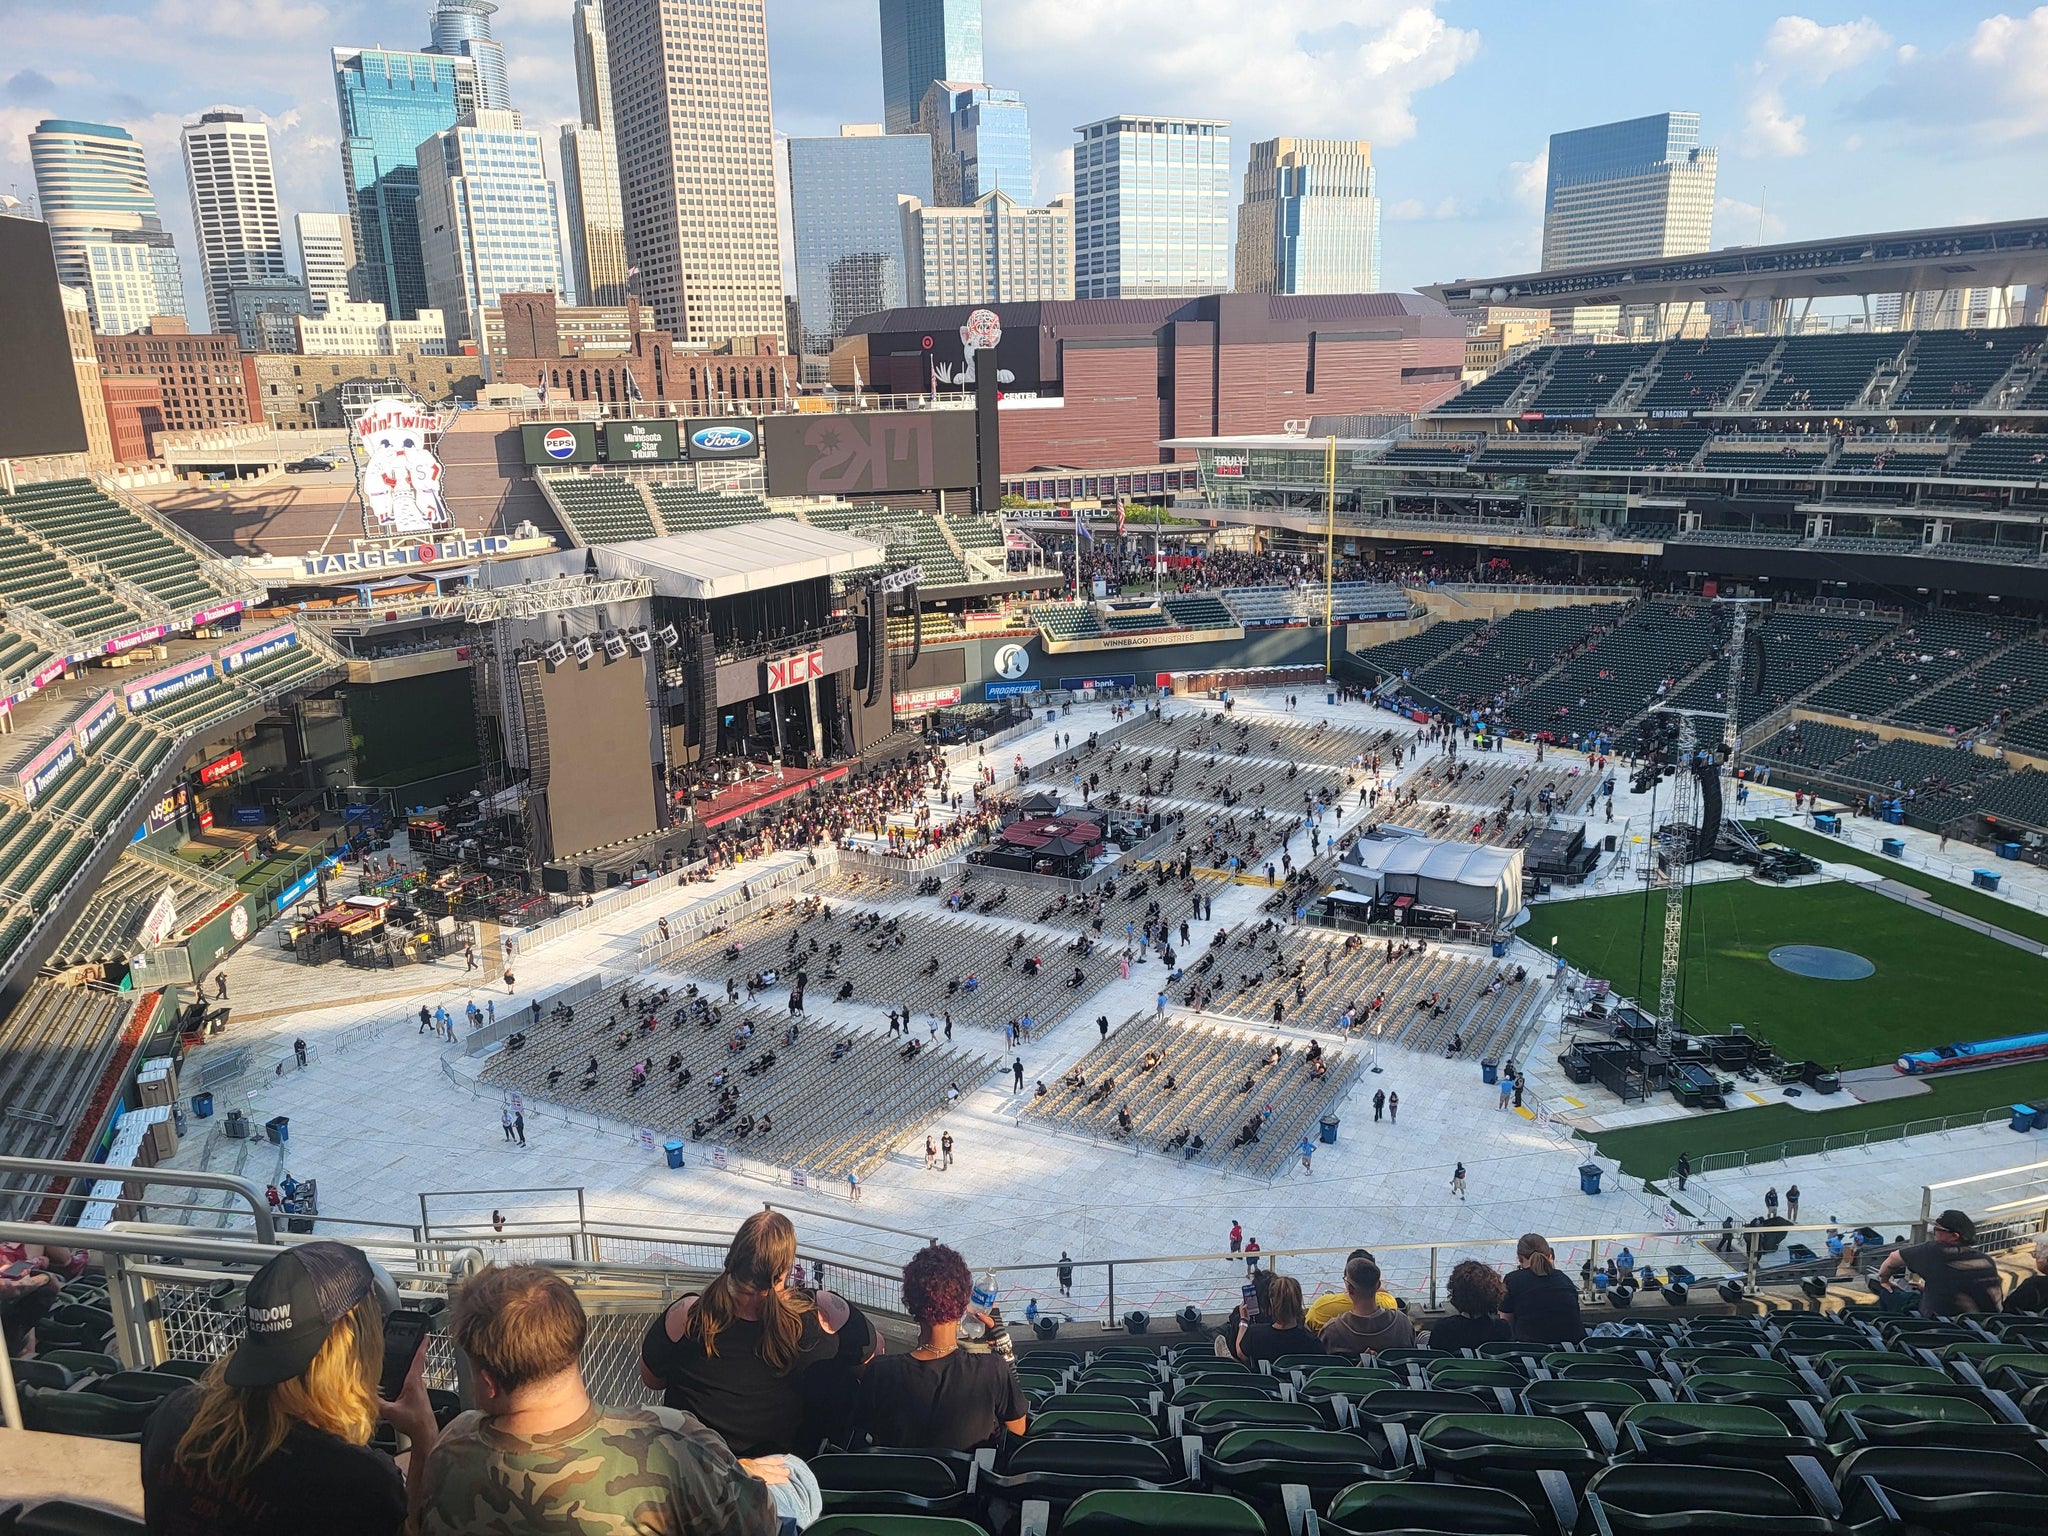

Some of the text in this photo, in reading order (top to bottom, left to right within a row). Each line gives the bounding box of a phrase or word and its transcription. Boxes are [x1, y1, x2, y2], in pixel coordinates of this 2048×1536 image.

[1003, 391, 1038, 401] CENTER
[1652, 410, 1688, 418] END RACISM
[356, 411, 443, 437] Win! Twins!
[631, 425, 646, 435] The
[546, 439, 574, 447] PEPSI
[624, 433, 663, 443] Minnesota
[704, 431, 741, 447] Ford
[641, 442, 658, 451] Star
[631, 449, 659, 458] Tribune
[1214, 455, 1245, 467] TRULY
[1005, 508, 1110, 518] TARGET FIELD
[306, 536, 510, 575] TARGET FIELD
[1241, 617, 1308, 627] Corona Corona Corona
[114, 627, 159, 651] Treasure Island
[1103, 634, 1195, 648] WINNEBAGO INDUSTRIES
[148, 668, 208, 701] Treasure Island
[1083, 679, 1115, 688] us bank
[936, 689, 955, 700] HERE
[988, 684, 1038, 695] PROGRESSIVE
[249, 1303, 291, 1322] WINDOW
[250, 1318, 294, 1334] CLEANING
